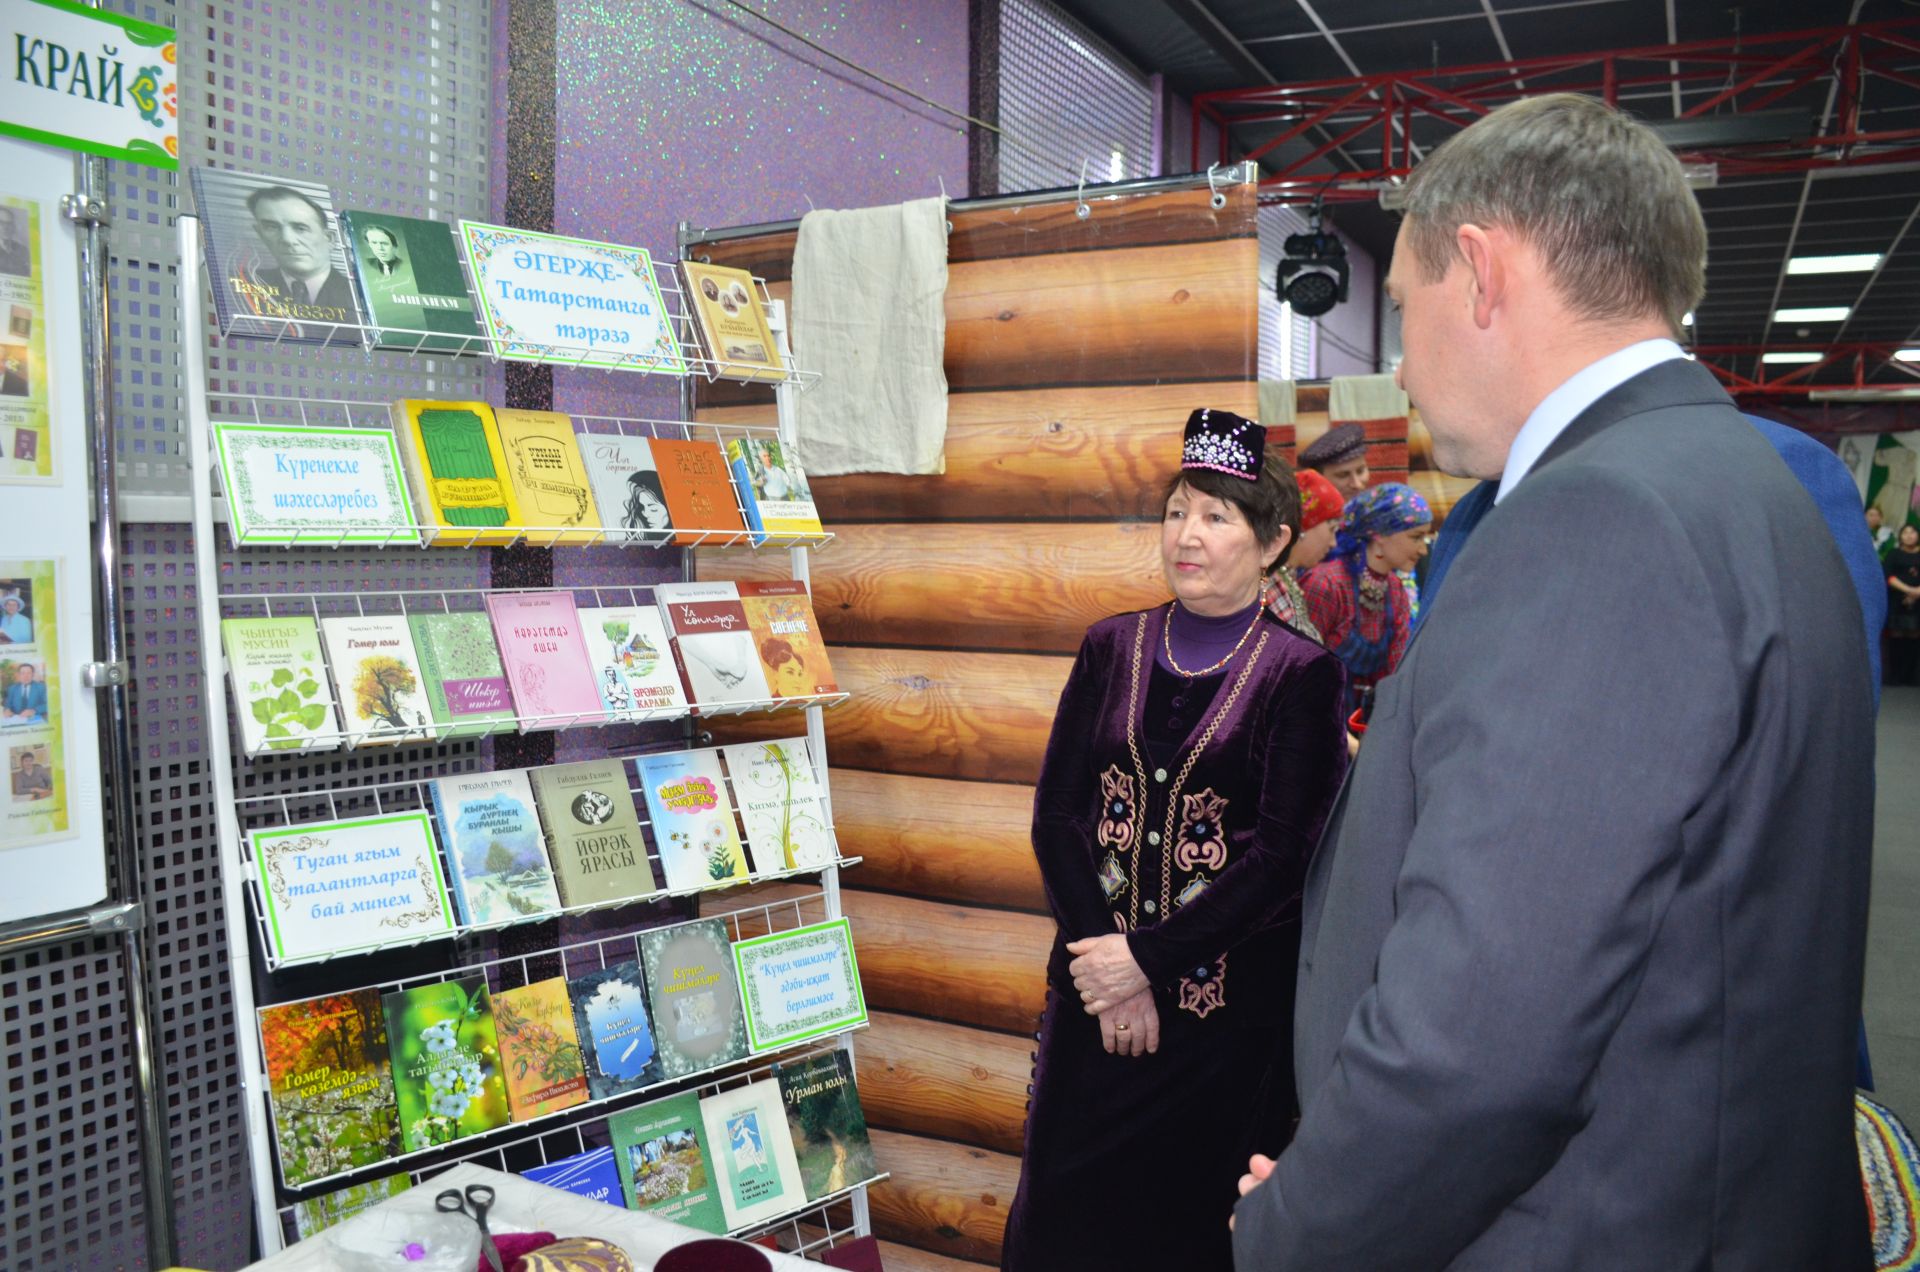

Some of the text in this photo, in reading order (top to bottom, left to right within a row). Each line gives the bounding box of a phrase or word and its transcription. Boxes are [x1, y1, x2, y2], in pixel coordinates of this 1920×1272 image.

[14, 33, 125, 108] КРАЙ
[514, 251, 625, 283] ӘГЕРҖЕ-
[496, 279, 651, 316] Татарстанга
[555, 320, 630, 346] тәрәзә
[275, 453, 360, 479] Күренекле
[273, 489, 378, 513] шәхесләребез
[680, 605, 696, 617] Ул
[242, 639, 289, 650] МУСИН
[347, 639, 377, 650] Гомер
[636, 697, 672, 708] КАРАМА
[464, 803, 499, 814] КЫРЫК
[468, 818, 510, 830] БУРАНЛЫ
[492, 825, 522, 835] КЫШЫ
[575, 833, 631, 857] ЙӨРӘК
[293, 846, 400, 874] Туган ягым
[580, 850, 636, 874] ЯРАСЫ
[287, 868, 418, 898] талантларга
[311, 893, 412, 920] бай минем
[285, 1066, 330, 1090] Гомер
[300, 1070, 357, 1099] көземдә
[342, 1077, 380, 1100] язым
[785, 1086, 824, 1104] Урман
